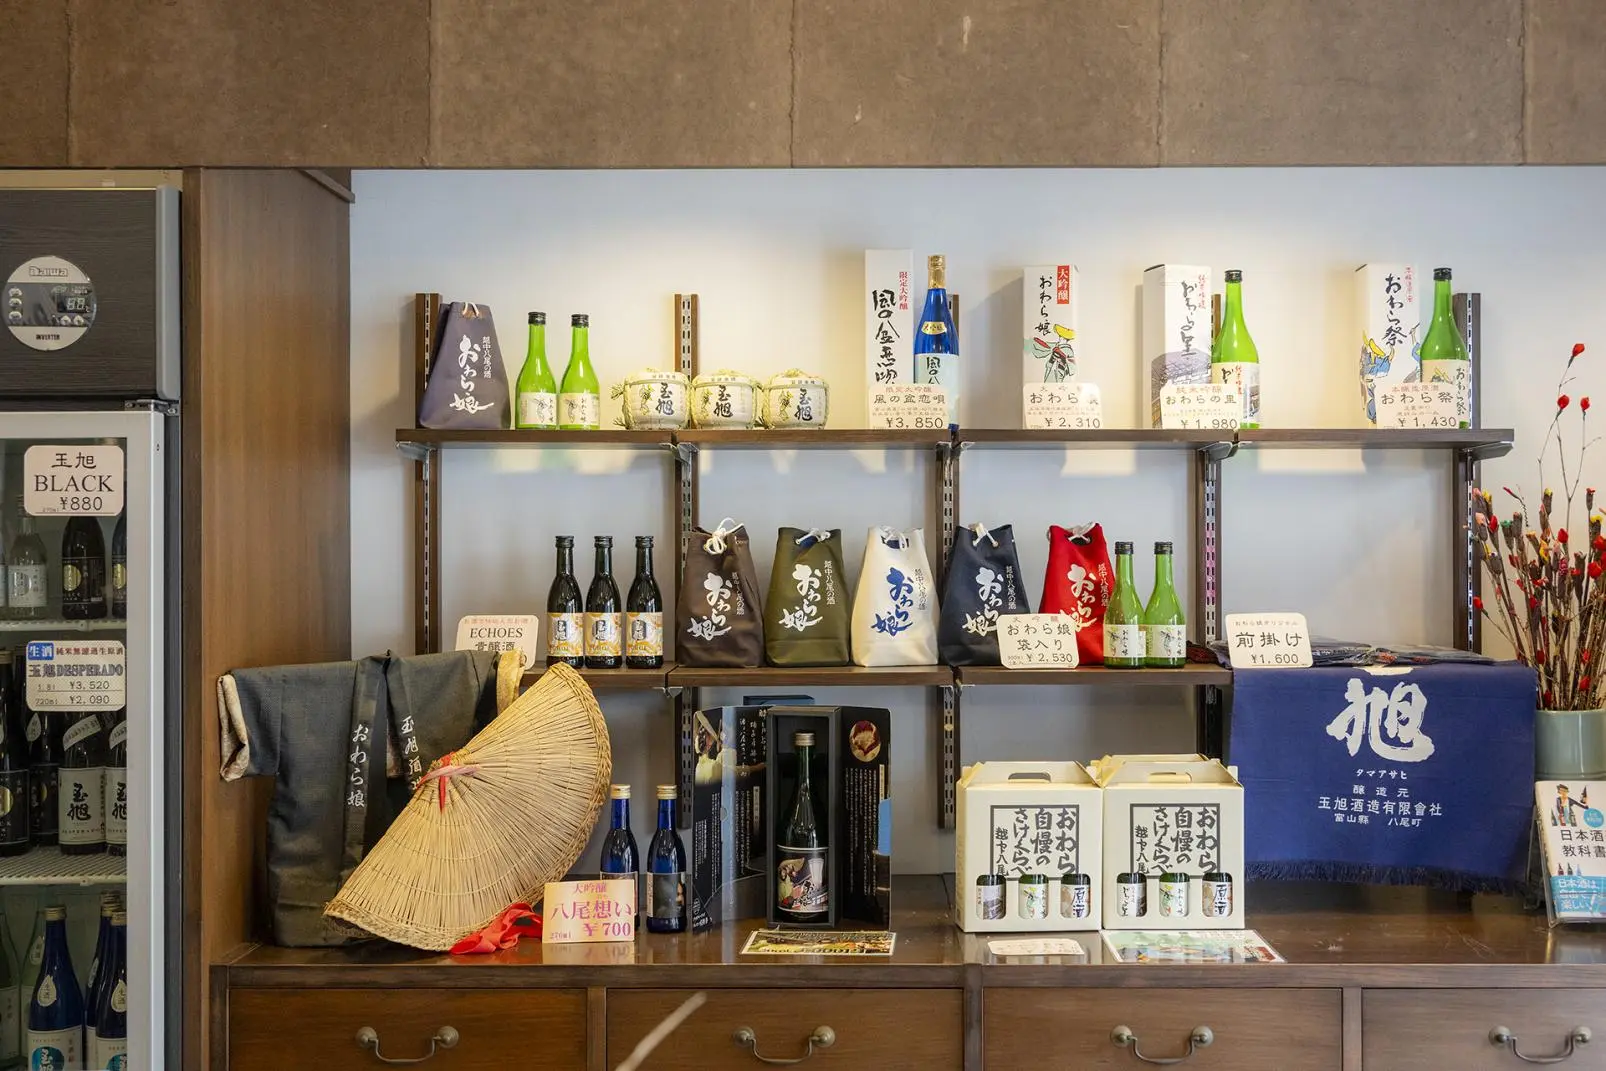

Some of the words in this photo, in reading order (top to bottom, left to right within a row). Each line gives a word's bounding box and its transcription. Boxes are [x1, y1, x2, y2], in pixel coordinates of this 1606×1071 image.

[1058, 268, 1069, 301] 大吟醸
[1035, 275, 1053, 337] おわら娘
[1381, 272, 1408, 346] おわら祭
[449, 334, 495, 414] おわら娘
[713, 385, 733, 418] 玉旭
[1165, 395, 1237, 405] おわらの里
[1381, 392, 1453, 405] おわら祭
[51, 452, 97, 469] 玉旭
[34, 475, 115, 493] BLACK
[60, 496, 103, 512] ¥880
[687, 572, 733, 641] おわら娘
[778, 563, 824, 632] おわら娘
[871, 566, 915, 637] おわら娘
[962, 566, 1005, 637] おわら娘
[470, 627, 524, 639] ECHOES
[1007, 623, 1073, 637] おわら娘
[1017, 638, 1063, 652] 袋入り
[1236, 632, 1303, 648] 前掛け
[29, 644, 54, 659] 生酒
[28, 664, 56, 678] 玉旭
[56, 664, 124, 677] DESPERADO
[346, 723, 369, 808] おわら娘
[1355, 768, 1408, 780] タマアサヒ
[67, 782, 92, 821] 玉旭
[1317, 796, 1443, 817] 玉旭酒造有限會社
[1030, 808, 1054, 866] 自慢の
[1171, 807, 1194, 864] 自慢の
[1333, 813, 1370, 825] 富山縣
[1387, 817, 1423, 828] 八尾町
[995, 827, 1010, 877] 越中八尾
[1011, 807, 1033, 875] さけくらべ
[1055, 807, 1077, 875] おわら
[1135, 825, 1150, 875] 越中八尾
[1151, 806, 1174, 875] さけくらべ
[1196, 807, 1218, 874] おわら
[573, 882, 607, 894] 大吟醸
[551, 900, 632, 921] 八尾想い
[584, 922, 632, 937] ¥700
